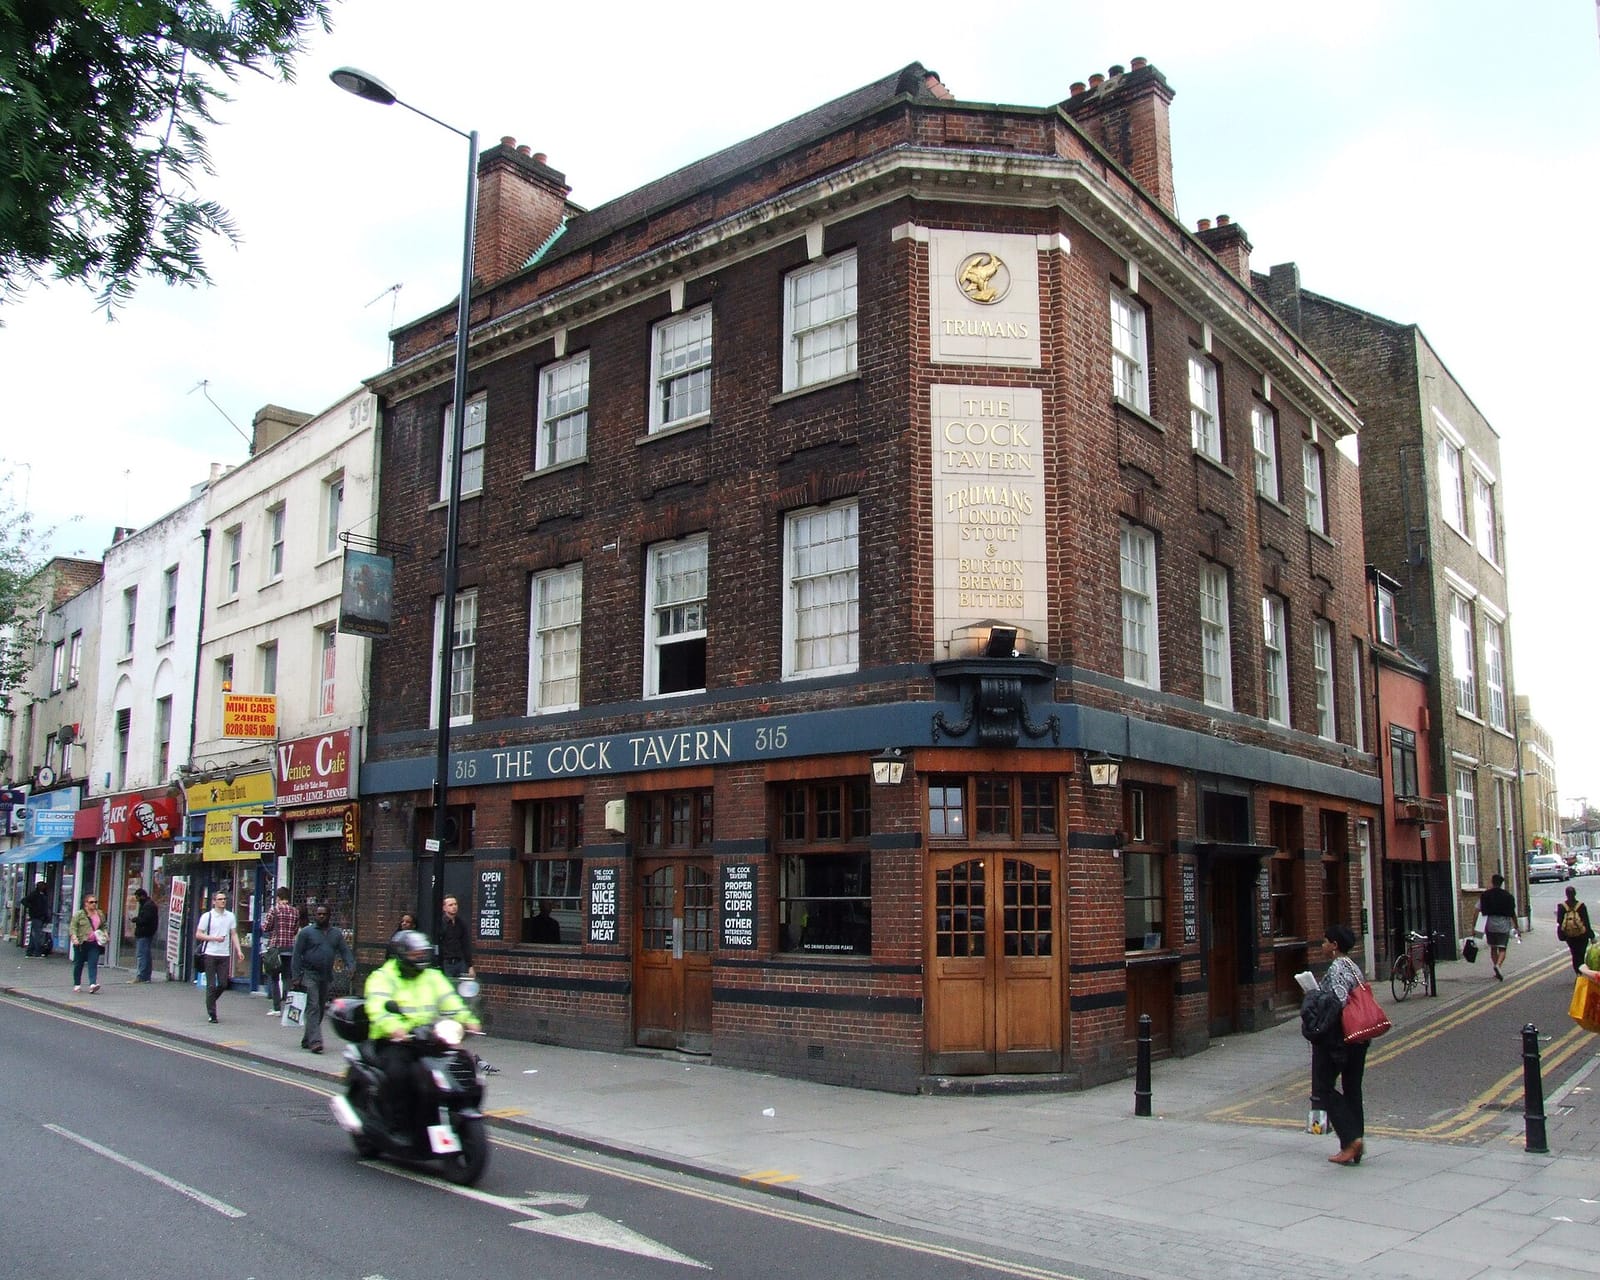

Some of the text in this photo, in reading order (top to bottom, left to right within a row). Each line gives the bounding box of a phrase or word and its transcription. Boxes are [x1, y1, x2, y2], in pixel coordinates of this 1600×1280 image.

[942, 319, 1028, 339] TRUMANS
[963, 400, 1010, 417] THE
[944, 421, 1031, 447] COCK
[943, 450, 1032, 470] TAVERN
[958, 509, 1022, 526] LONDON
[961, 526, 1019, 541] STOUT
[985, 543, 998, 557] &
[958, 559, 1024, 574] BURTON
[959, 576, 1023, 591] BREWED
[959, 592, 1024, 609] BITTERS
[226, 703, 275, 713] MINI CABS
[234, 714, 267, 722] 24HRS
[226, 723, 243, 735] 0208
[455, 725, 788, 779] 315 THE COCK TAVERN 315
[279, 736, 346, 782] Venice Café
[277, 788, 348, 805] BREAKFAST LUNCH DINNER
[110, 806, 127, 823] KFC
[254, 842, 275, 850] OPEN
[482, 872, 501, 882] OPEN
[725, 882, 752, 890] PROPER
[592, 891, 615, 902] NICE
[725, 891, 752, 899] STRONG
[171, 898, 183, 914] CABS
[592, 903, 615, 914] BEER
[725, 900, 752, 911] CIDER
[481, 918, 499, 928] BEER
[592, 920, 615, 928] LOVELY
[725, 919, 752, 928] OTHER
[591, 929, 615, 940] MEAT
[1185, 926, 1195, 935] YOU
[725, 936, 752, 945] THINGS
